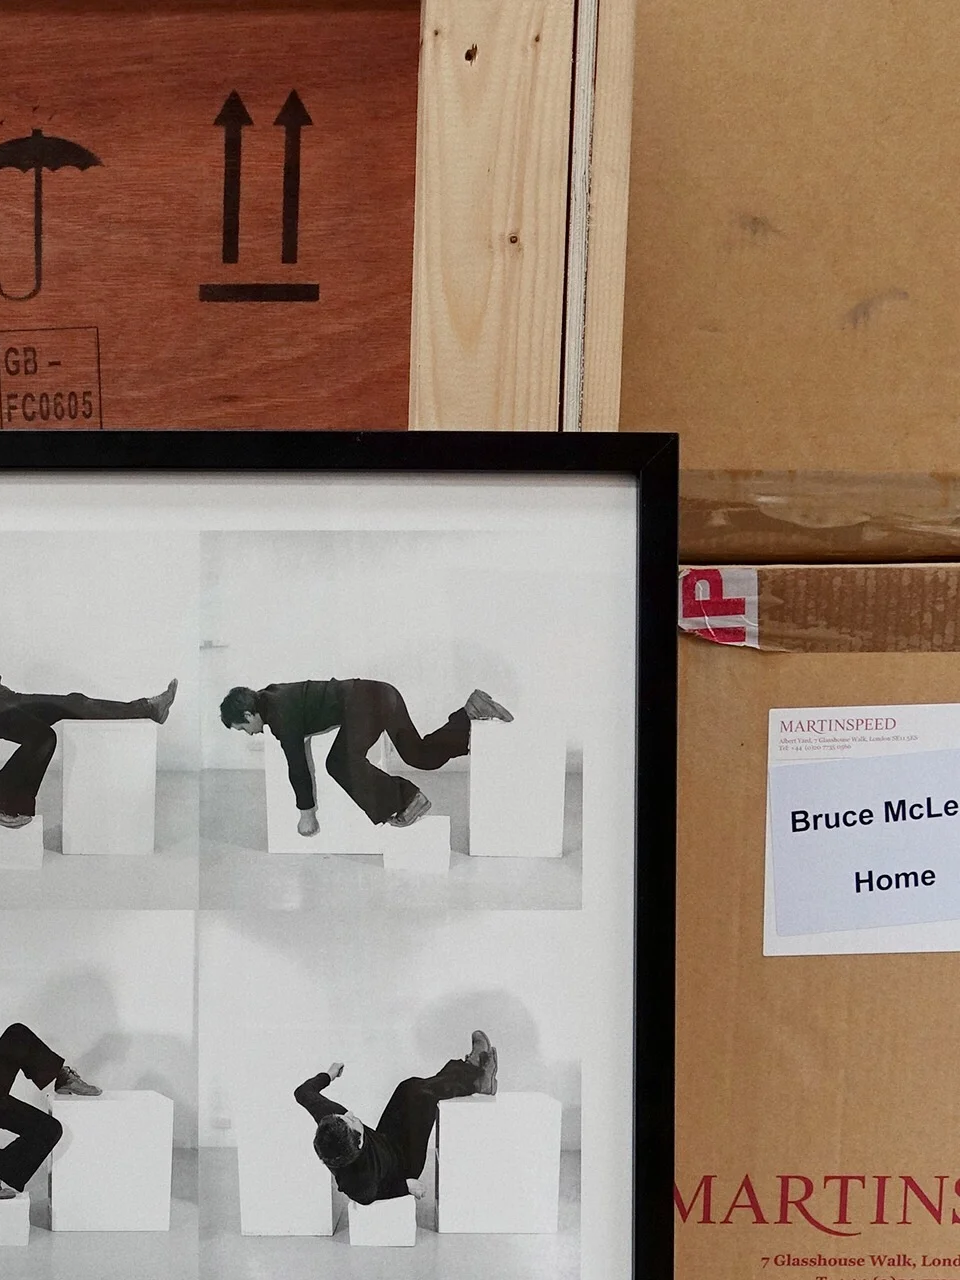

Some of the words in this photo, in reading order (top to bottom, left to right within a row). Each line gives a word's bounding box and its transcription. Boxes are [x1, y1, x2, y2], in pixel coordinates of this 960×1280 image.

[4, 346, 38, 376] GB
[780, 717, 897, 735] MARTINSPEED
[791, 808, 874, 833] Bruce
[884, 797, 959, 823] McLe
[855, 869, 936, 893] Home
[761, 1257, 770, 1268] 7
[774, 1254, 865, 1267] Glasshouse
[869, 1254, 917, 1269] Walk,
